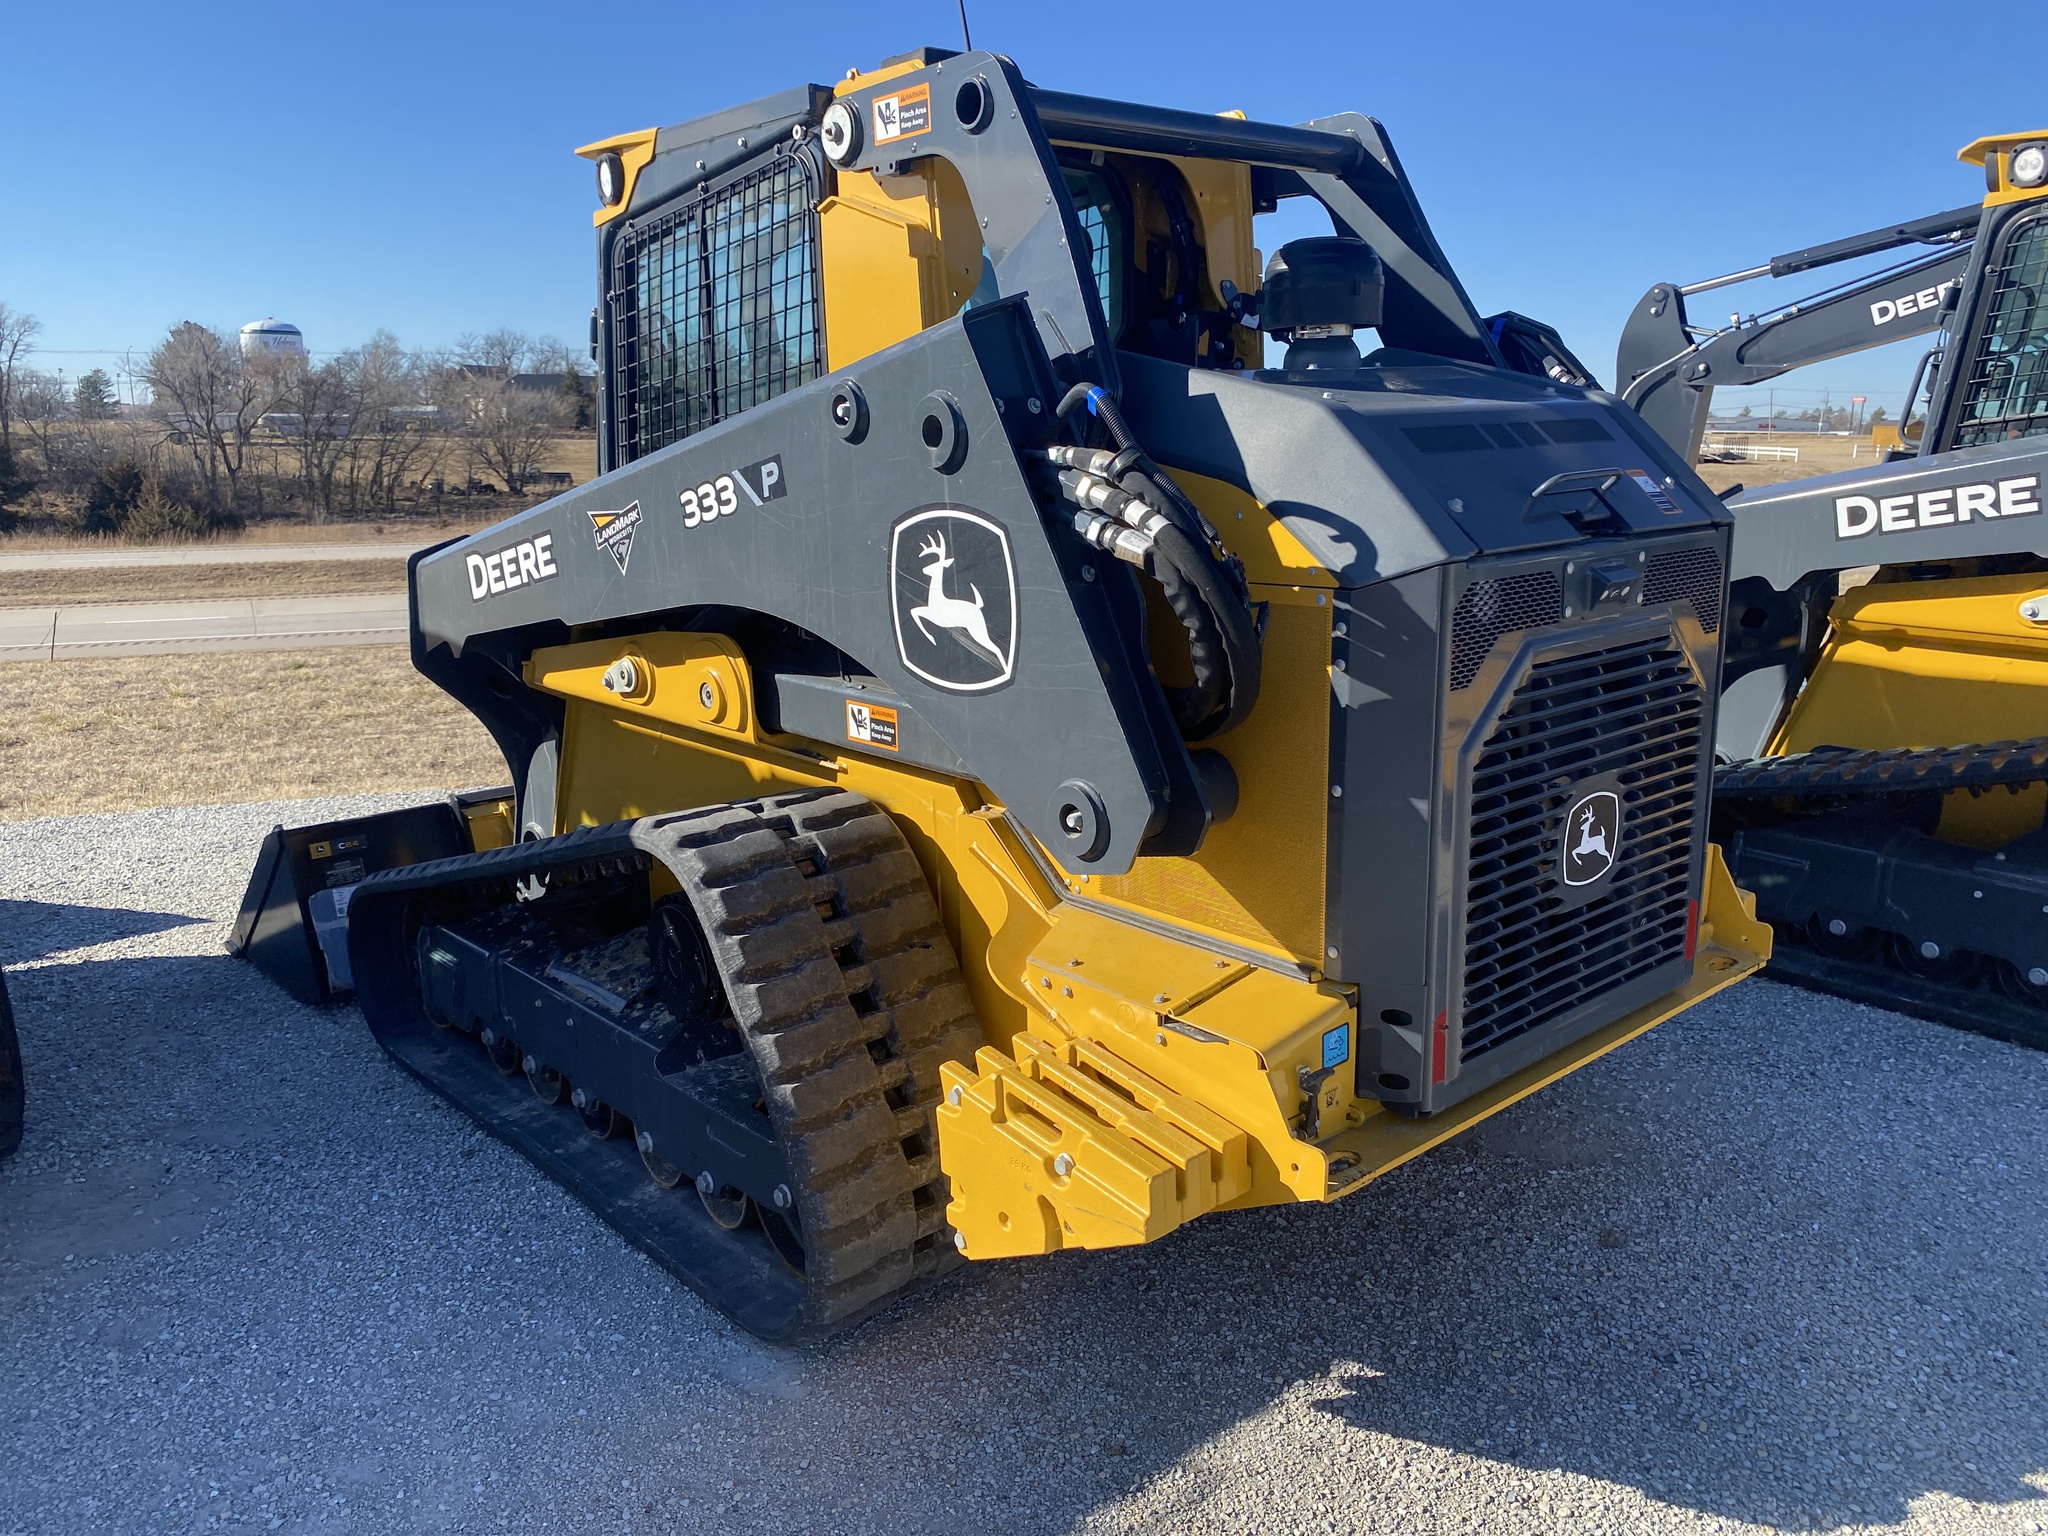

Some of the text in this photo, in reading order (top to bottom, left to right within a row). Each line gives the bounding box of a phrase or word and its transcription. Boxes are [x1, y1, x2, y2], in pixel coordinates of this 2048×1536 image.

[905, 88, 927, 101] WARNING
[900, 106, 927, 120] Pinch Area
[901, 118, 924, 129] Keep Away
[680, 475, 738, 528] 333
[1835, 476, 2039, 538] DEERE
[596, 508, 640, 544] LANDMARK
[608, 525, 633, 546] WORKSITE
[466, 534, 557, 600] DEERE
[871, 722, 895, 734] Pinch Area
